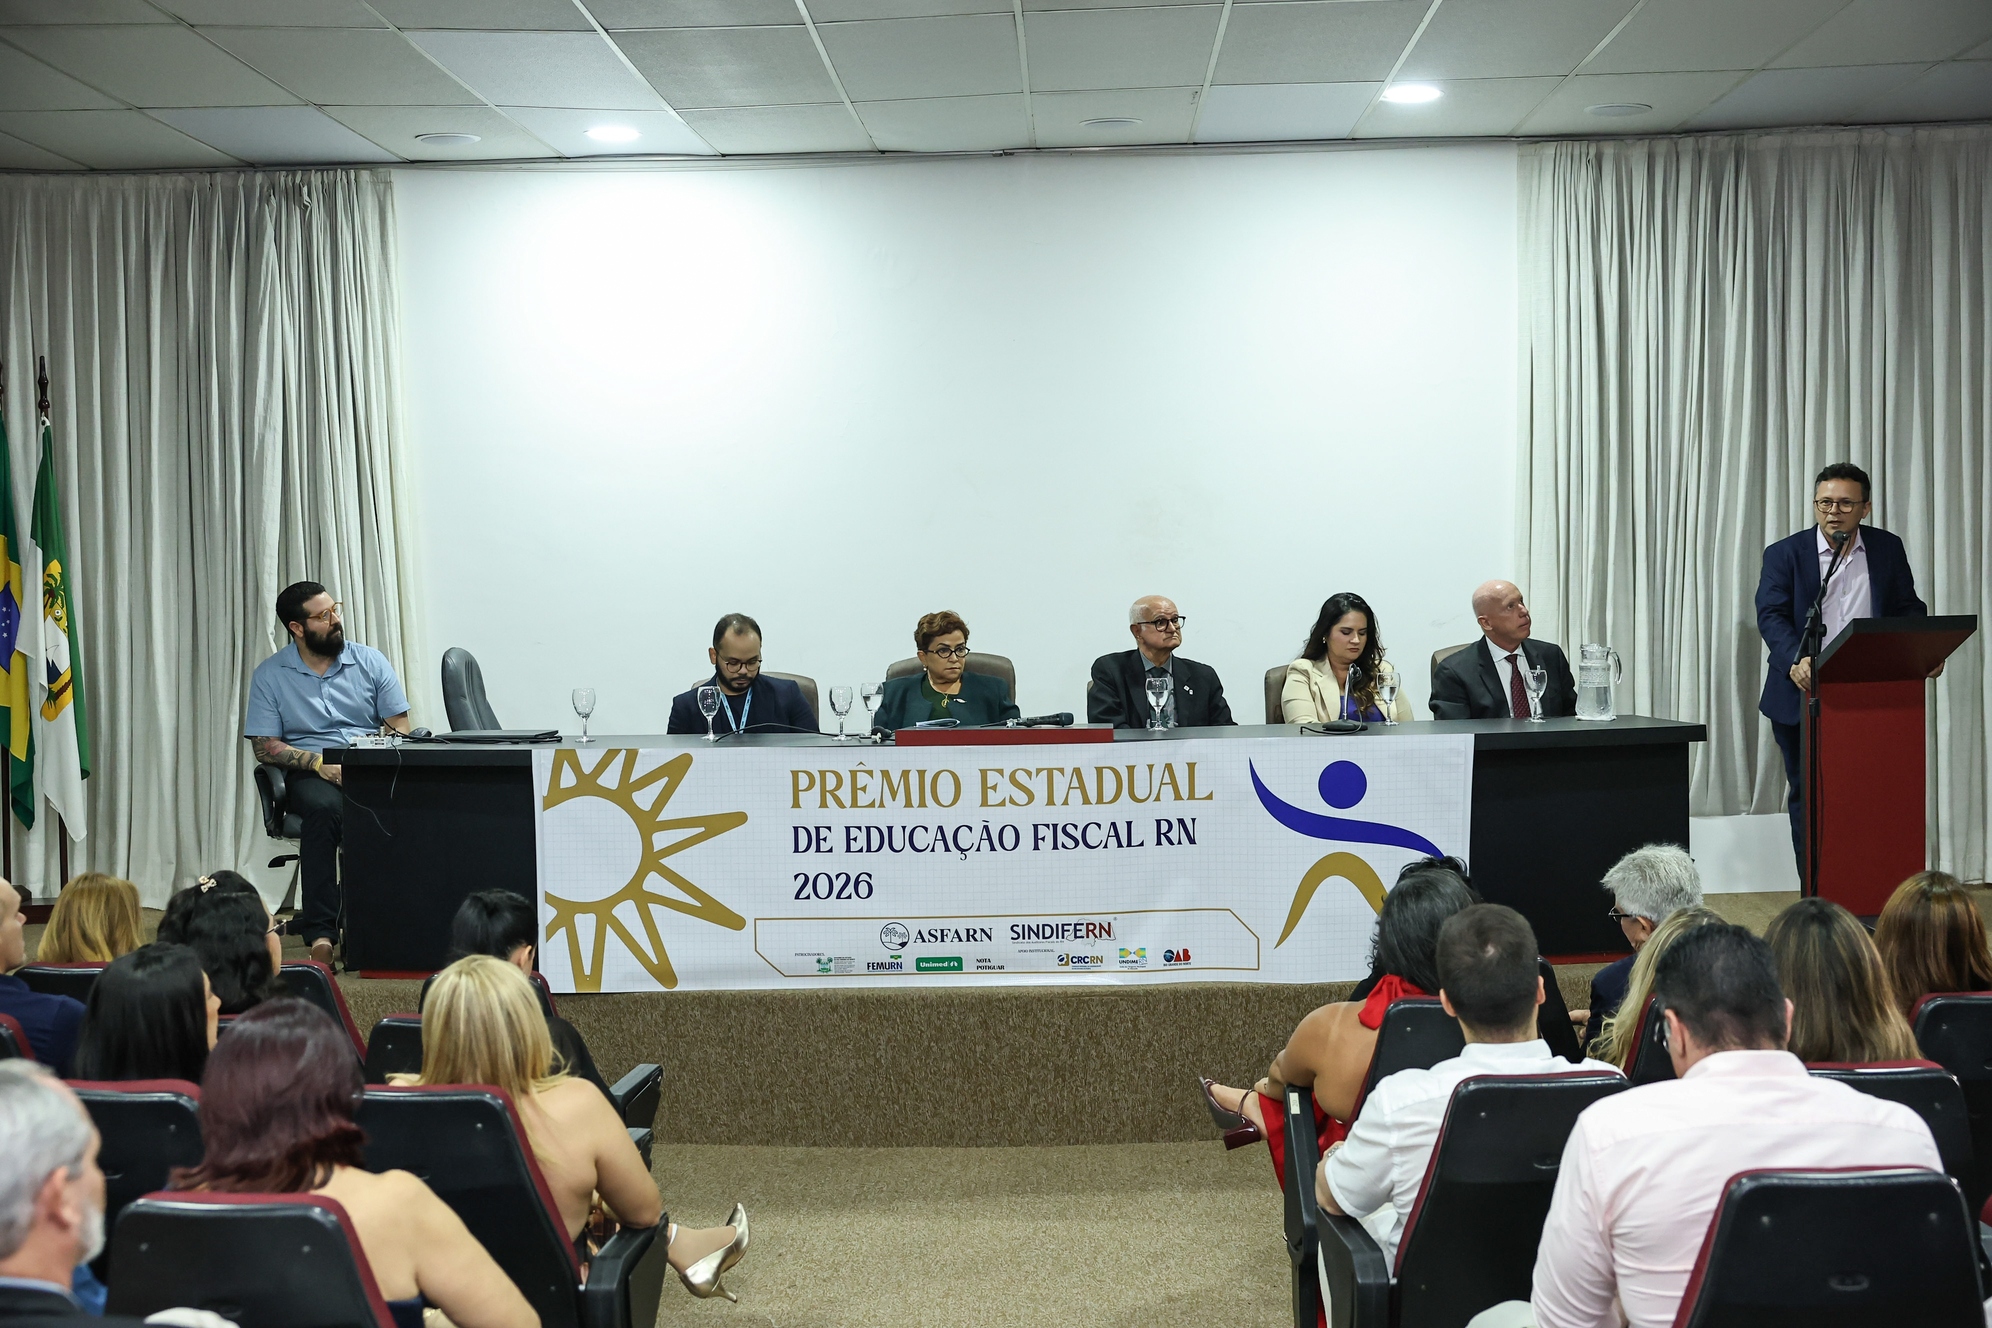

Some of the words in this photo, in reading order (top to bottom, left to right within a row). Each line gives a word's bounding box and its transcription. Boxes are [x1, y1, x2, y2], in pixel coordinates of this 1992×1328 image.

[790, 761, 962, 809] PRÊMIO
[978, 762, 1214, 807] ESTADUAL
[792, 825, 833, 853] DE
[844, 820, 1020, 861] EDUCAÇÃO
[1032, 820, 1145, 851] FISCAL
[1154, 818, 1197, 847] RN
[793, 872, 874, 900] 2026
[913, 927, 993, 943] ASFARN
[1010, 922, 1112, 941] SINDIFERN
[1070, 955, 1103, 965] CRCRN
[1163, 948, 1192, 962] OAB
[867, 961, 903, 970] FEMURN
[920, 960, 948, 968] Unimed
